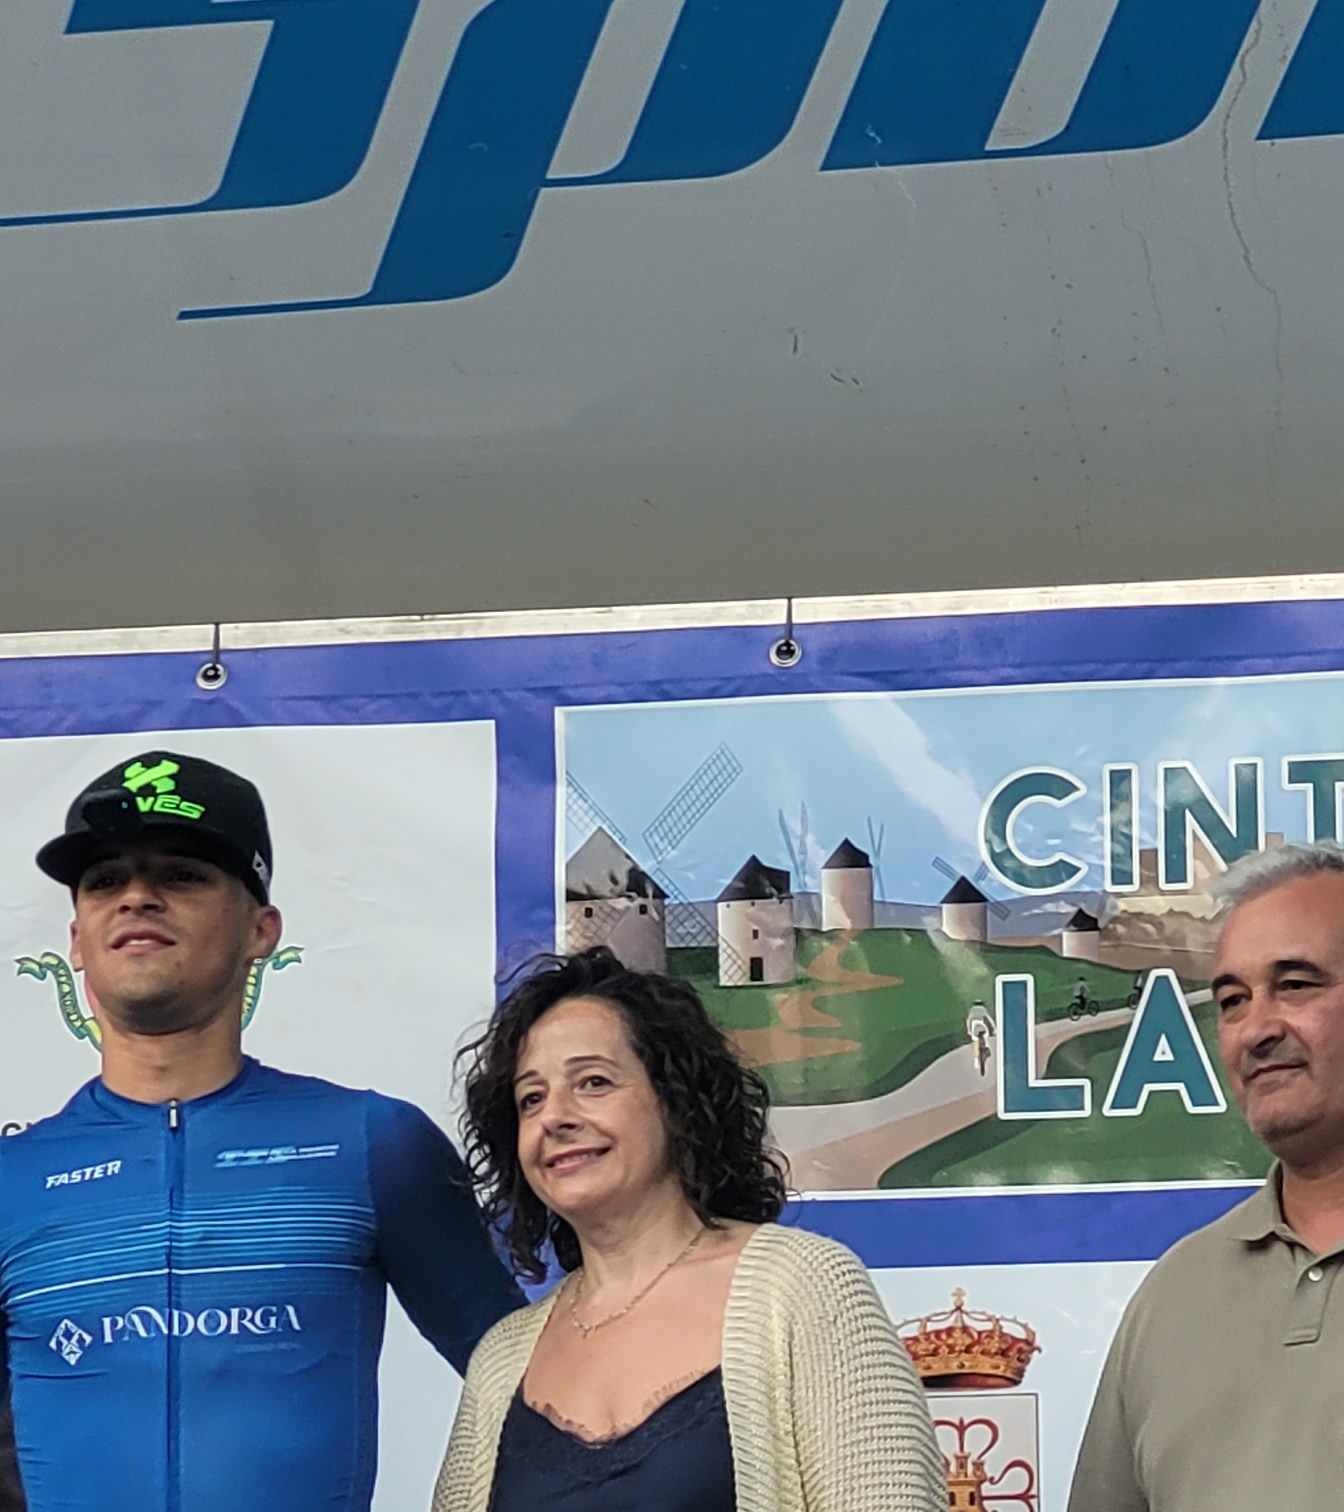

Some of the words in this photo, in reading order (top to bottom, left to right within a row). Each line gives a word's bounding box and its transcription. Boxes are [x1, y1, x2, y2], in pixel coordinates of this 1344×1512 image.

[994, 967, 1228, 1120] LA
[45, 1160, 122, 1189] FASTER
[101, 1304, 302, 1345] PANDORGA
